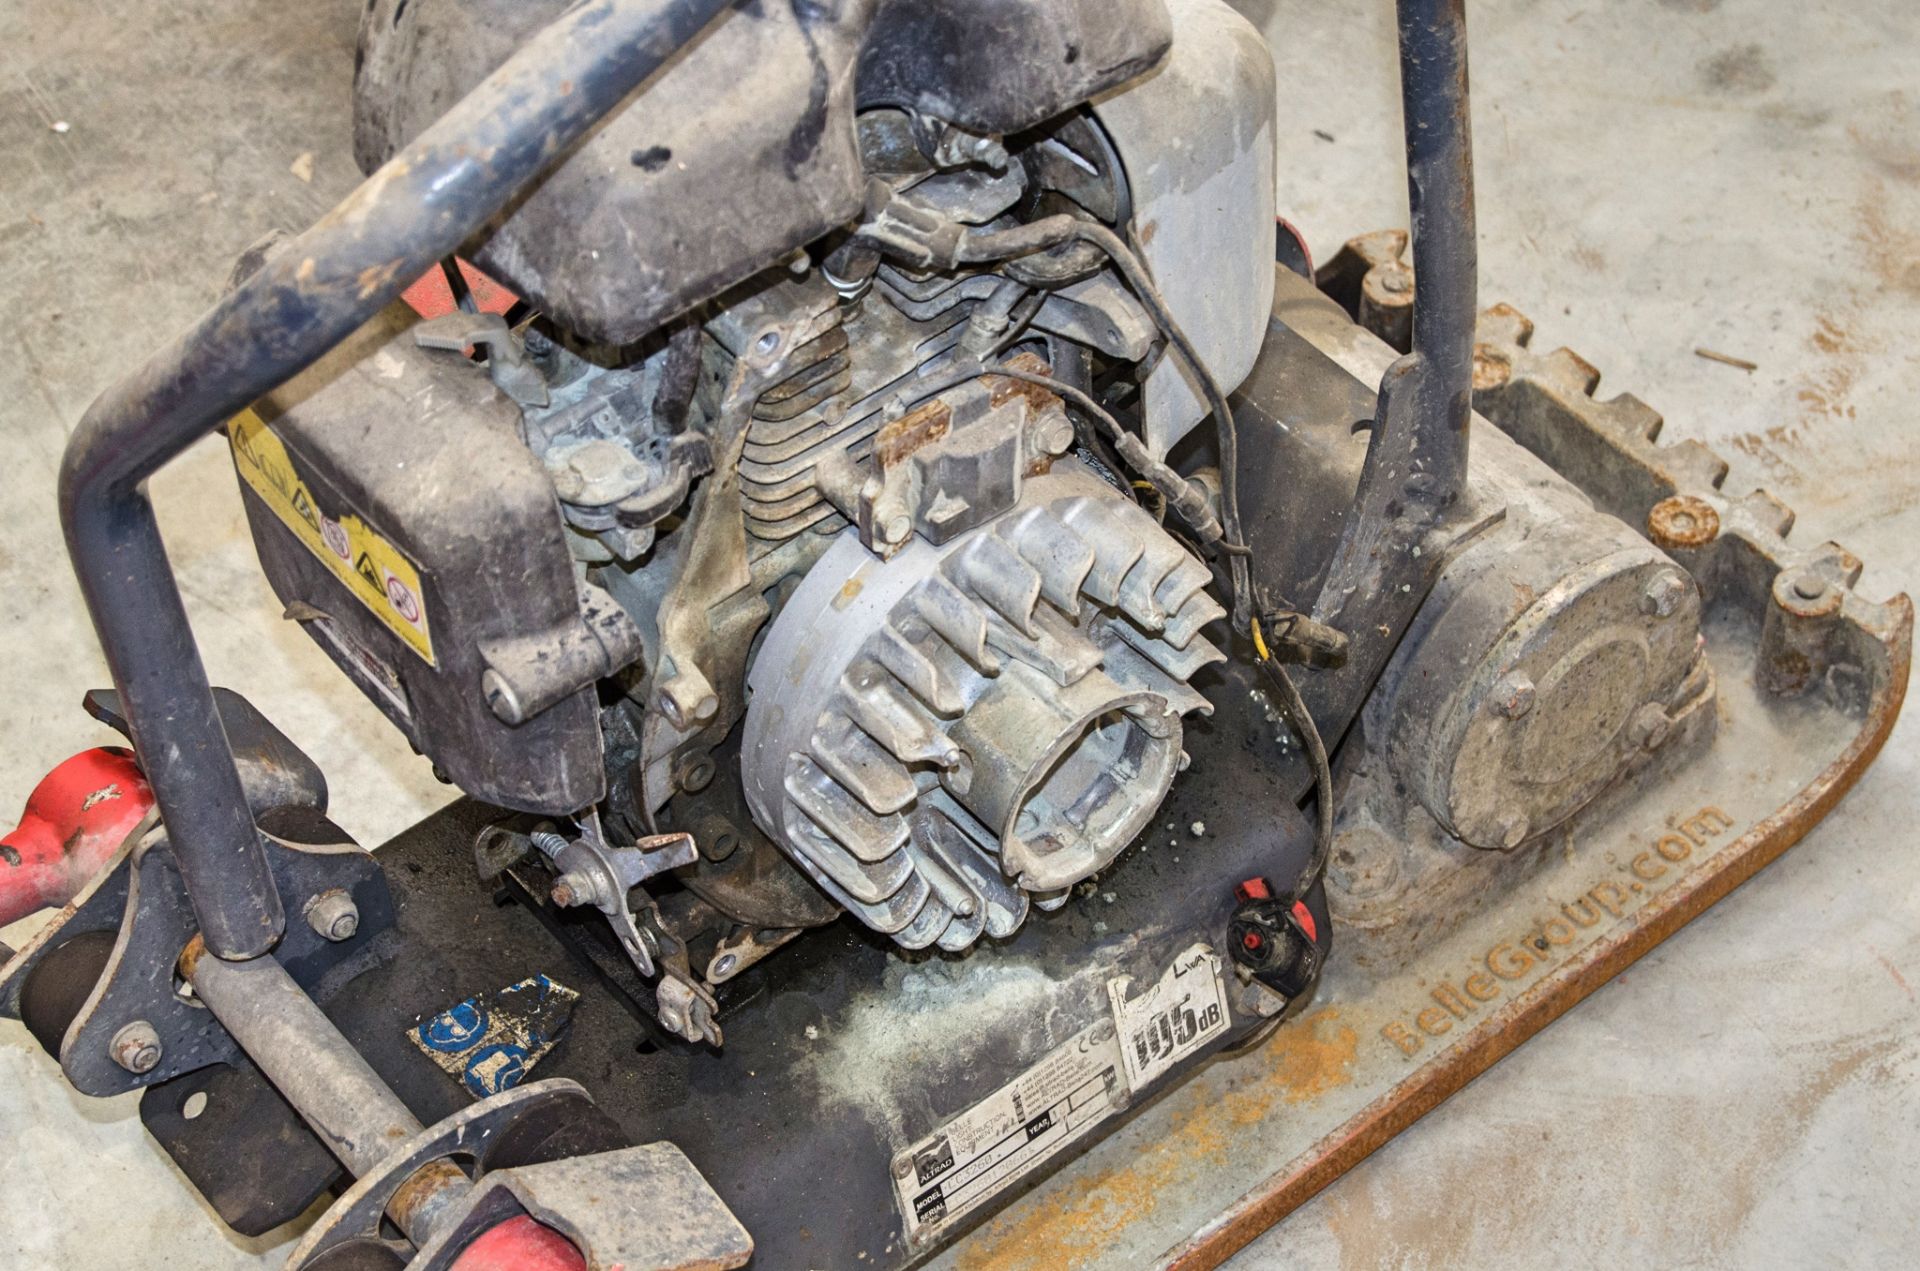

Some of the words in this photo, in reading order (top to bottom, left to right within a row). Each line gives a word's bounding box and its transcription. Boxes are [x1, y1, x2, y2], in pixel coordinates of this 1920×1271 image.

[1380, 805, 1734, 1055] BelleGroup.com
[915, 1189, 941, 1211] MODEL
[1028, 1117, 1048, 1136] YEAR
[919, 1157, 952, 1184] ALTRAD
